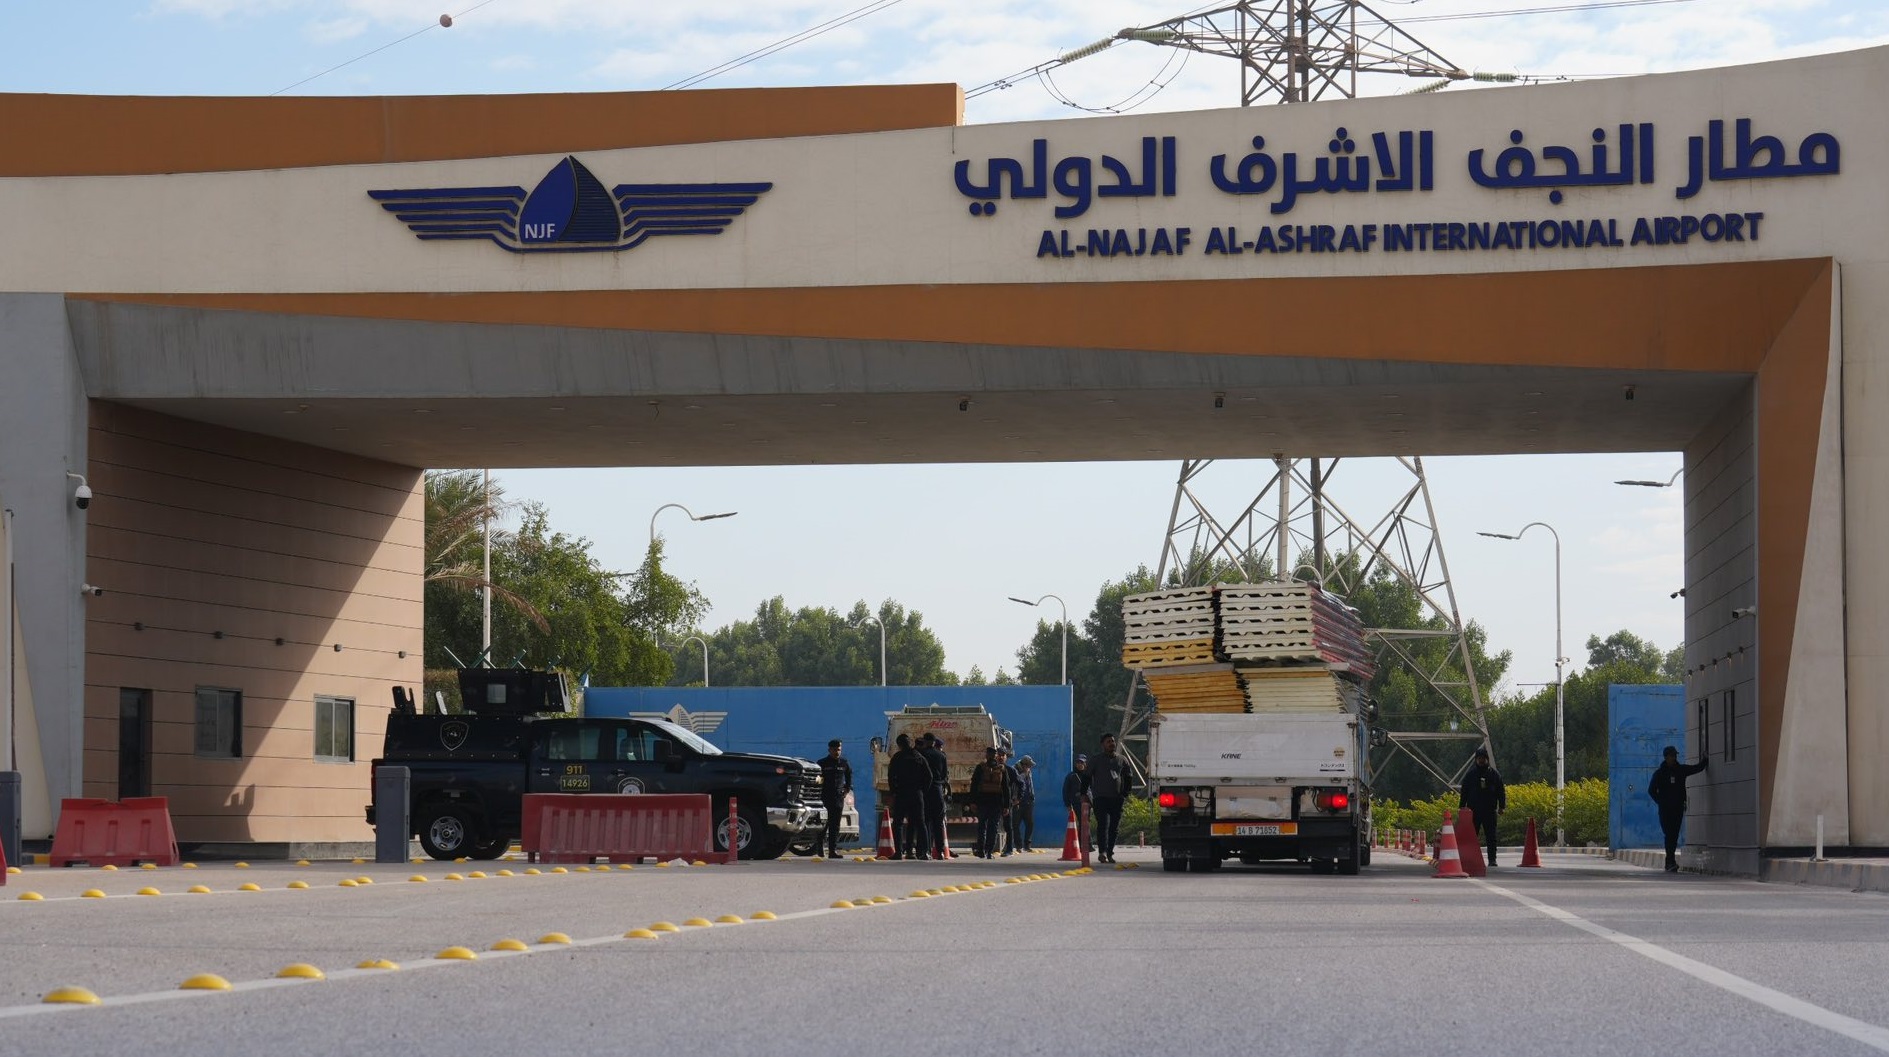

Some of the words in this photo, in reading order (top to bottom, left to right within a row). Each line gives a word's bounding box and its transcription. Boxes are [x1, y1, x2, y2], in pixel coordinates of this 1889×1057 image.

[954, 136, 1177, 218] الدولي
[1210, 127, 1434, 214] الاشرف
[1468, 122, 1655, 204] النجف
[1676, 118, 1841, 199] مطار
[524, 223, 556, 239] NJF
[1037, 227, 1191, 257] AL-NAJAF
[1204, 224, 1378, 255] AL-ASHRAF
[1383, 219, 1624, 252] INTERNATIONAL
[1630, 212, 1764, 246] AIRPORT
[562, 779, 588, 788] 14926
[566, 765, 583, 775] 911
